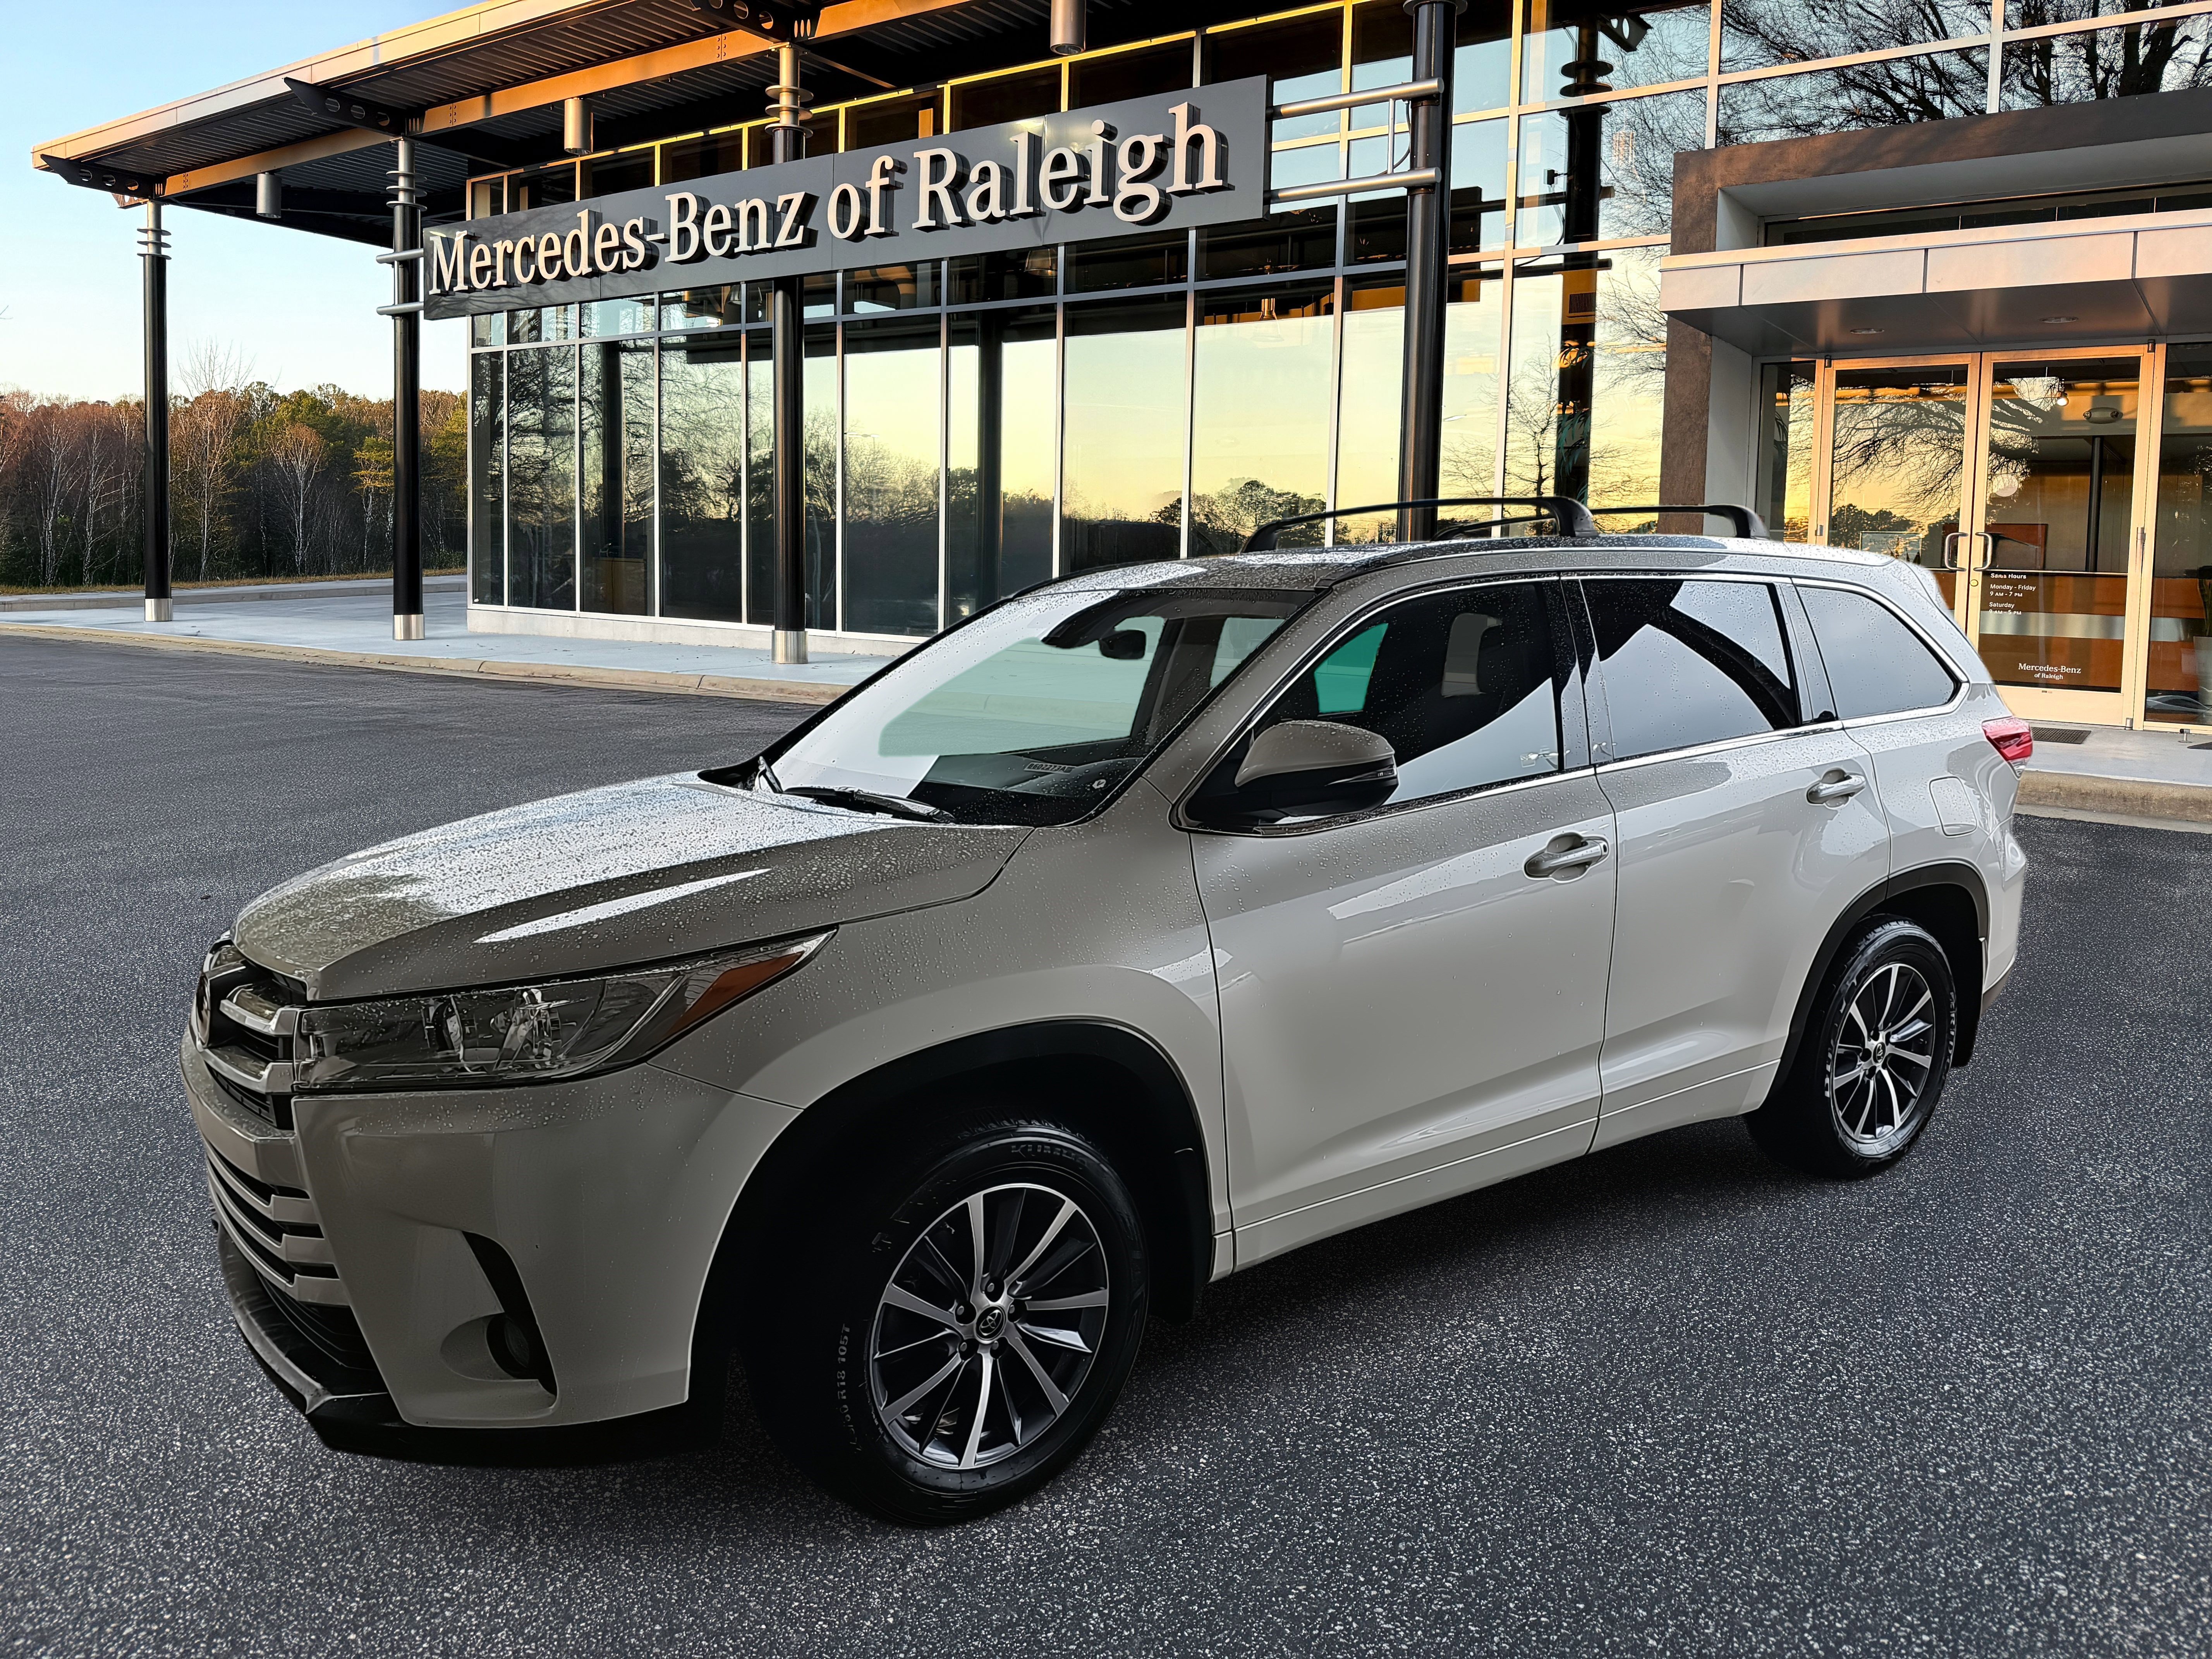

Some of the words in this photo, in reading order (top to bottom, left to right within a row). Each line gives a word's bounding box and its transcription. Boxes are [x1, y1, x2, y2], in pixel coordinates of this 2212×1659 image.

[429, 191, 804, 295] Mercedes-Benz
[827, 155, 894, 239] of
[911, 101, 1223, 229] Raleigh
[2018, 663, 2081, 673] Mercedes-Benz
[837, 1323, 851, 1364] 105T
